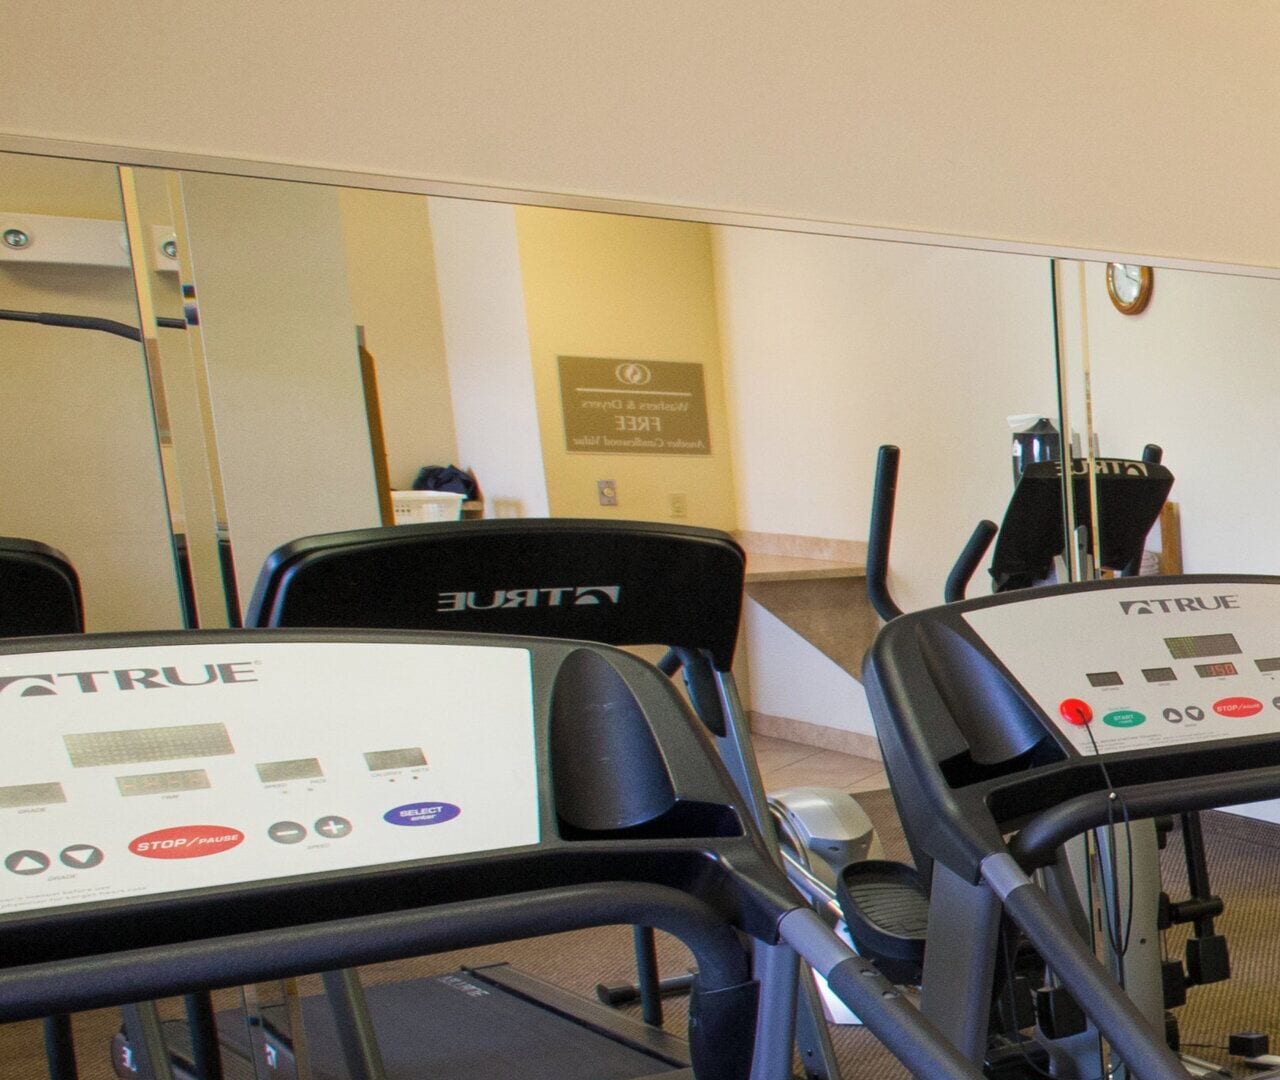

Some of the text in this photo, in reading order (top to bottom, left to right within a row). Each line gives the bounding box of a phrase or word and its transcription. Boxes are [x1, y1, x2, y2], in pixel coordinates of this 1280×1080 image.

[1150, 594, 1241, 614] TRUE
[57, 661, 259, 694] TRUE
[400, 806, 443, 818] SELECT
[137, 833, 239, 852] STOP/PAUSE
